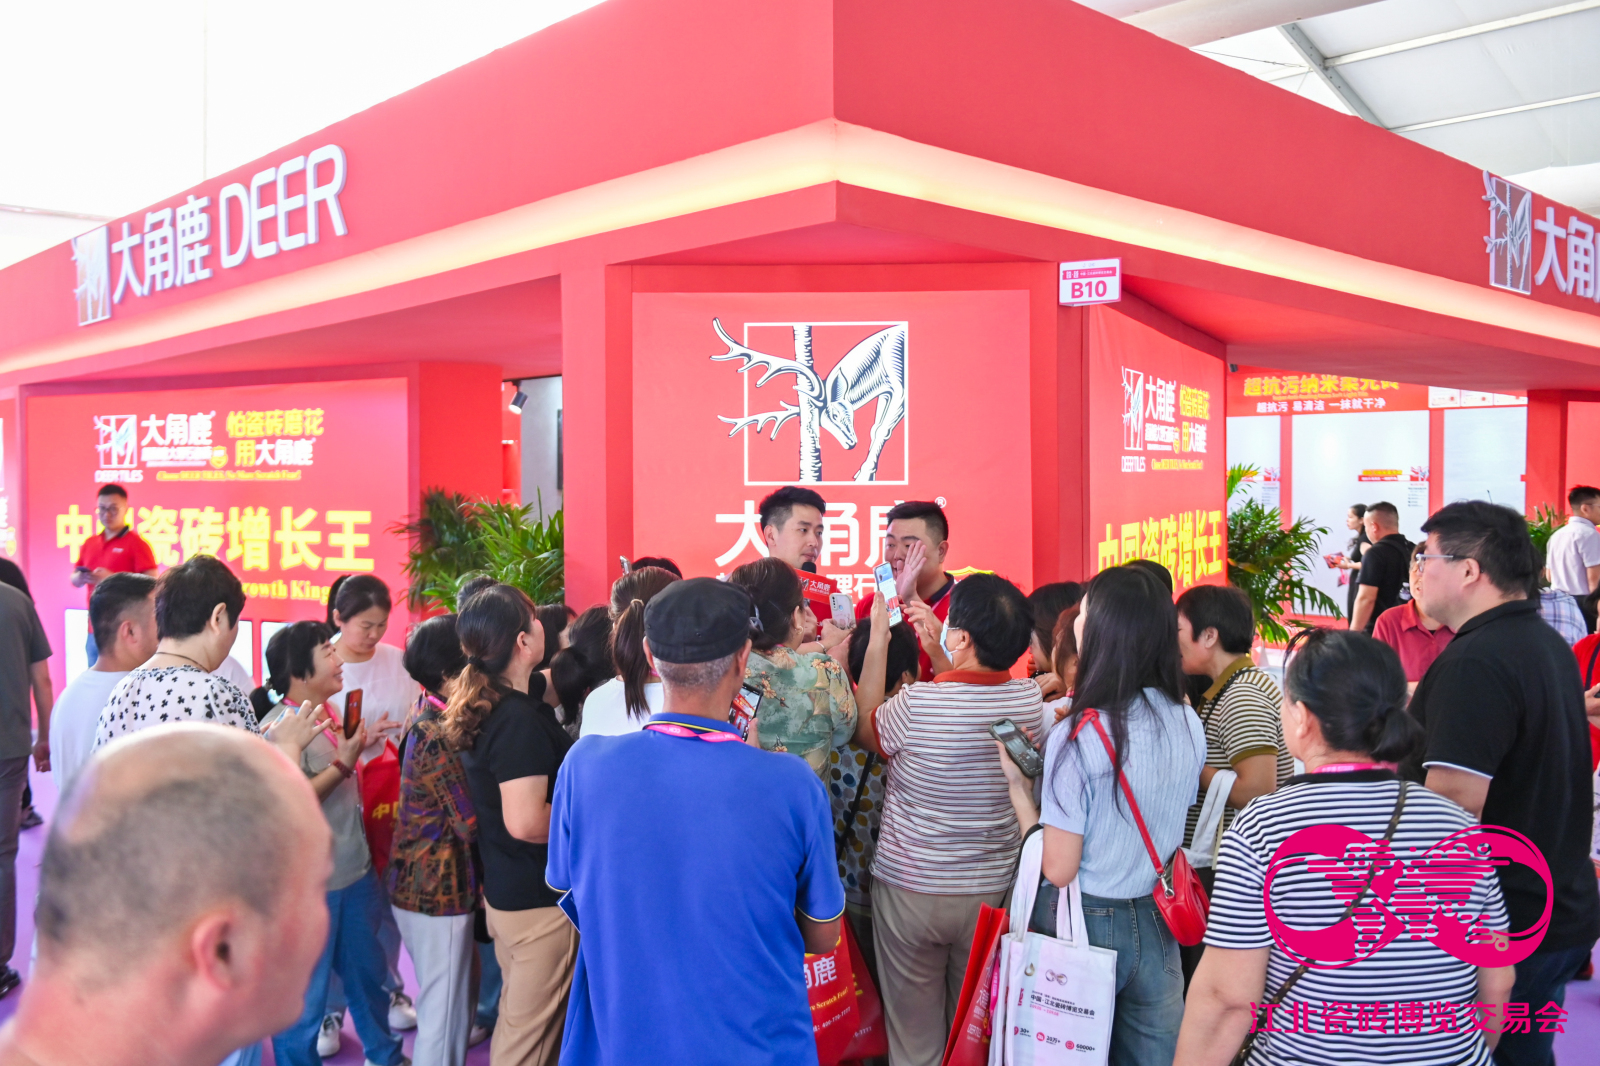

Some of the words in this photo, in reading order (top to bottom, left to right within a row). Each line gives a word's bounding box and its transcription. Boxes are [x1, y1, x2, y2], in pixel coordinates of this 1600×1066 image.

[111, 194, 213, 304] 大角鹿
[219, 144, 348, 268] DEER
[1534, 207, 1600, 303] 大角
[1071, 280, 1107, 299] B10
[141, 412, 212, 446] 大角鹿
[235, 438, 314, 466] 用大角鹿
[57, 504, 375, 571] 中瓷砖增长王
[242, 579, 288, 599] rowth
[816, 995, 837, 1008] Scratch
